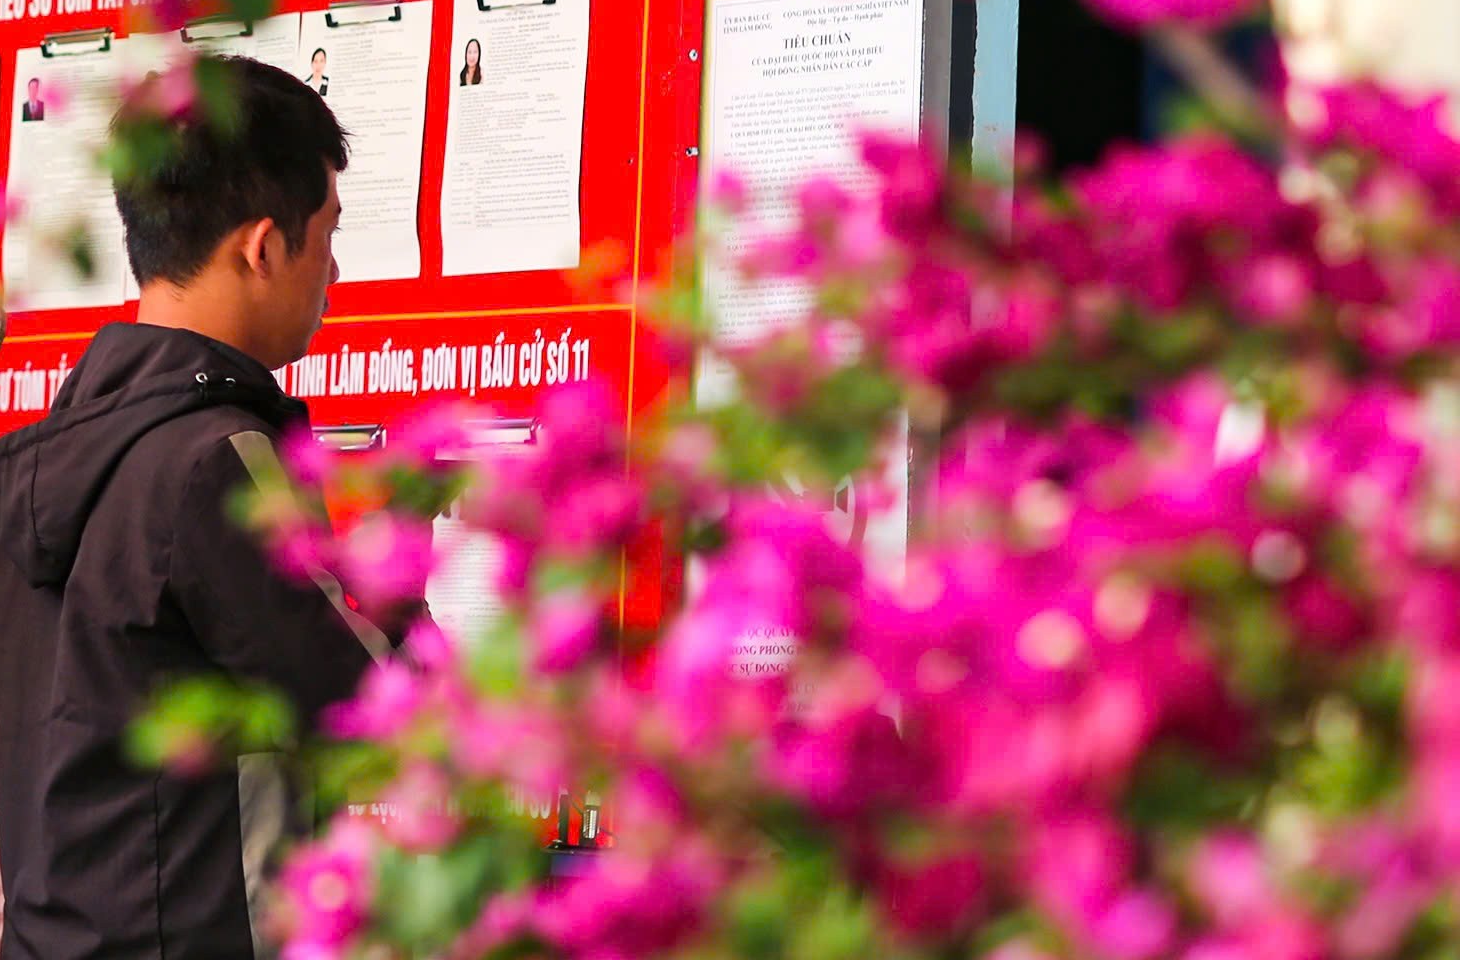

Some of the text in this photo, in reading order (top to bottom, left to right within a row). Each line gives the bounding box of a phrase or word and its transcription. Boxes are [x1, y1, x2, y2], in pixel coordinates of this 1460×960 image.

[783, 34, 809, 49] TIÊU
[13, 361, 46, 411] TÓM
[48, 352, 74, 409] TẮ
[329, 344, 365, 395] LÂM
[367, 338, 418, 397] ĐỒNG,
[421, 343, 456, 391] ĐƠN
[461, 346, 477, 397] VỊ
[480, 331, 515, 389] BẦU
[519, 328, 545, 387] CỬ
[546, 327, 572, 386] SỐ
[572, 338, 590, 382] 11
